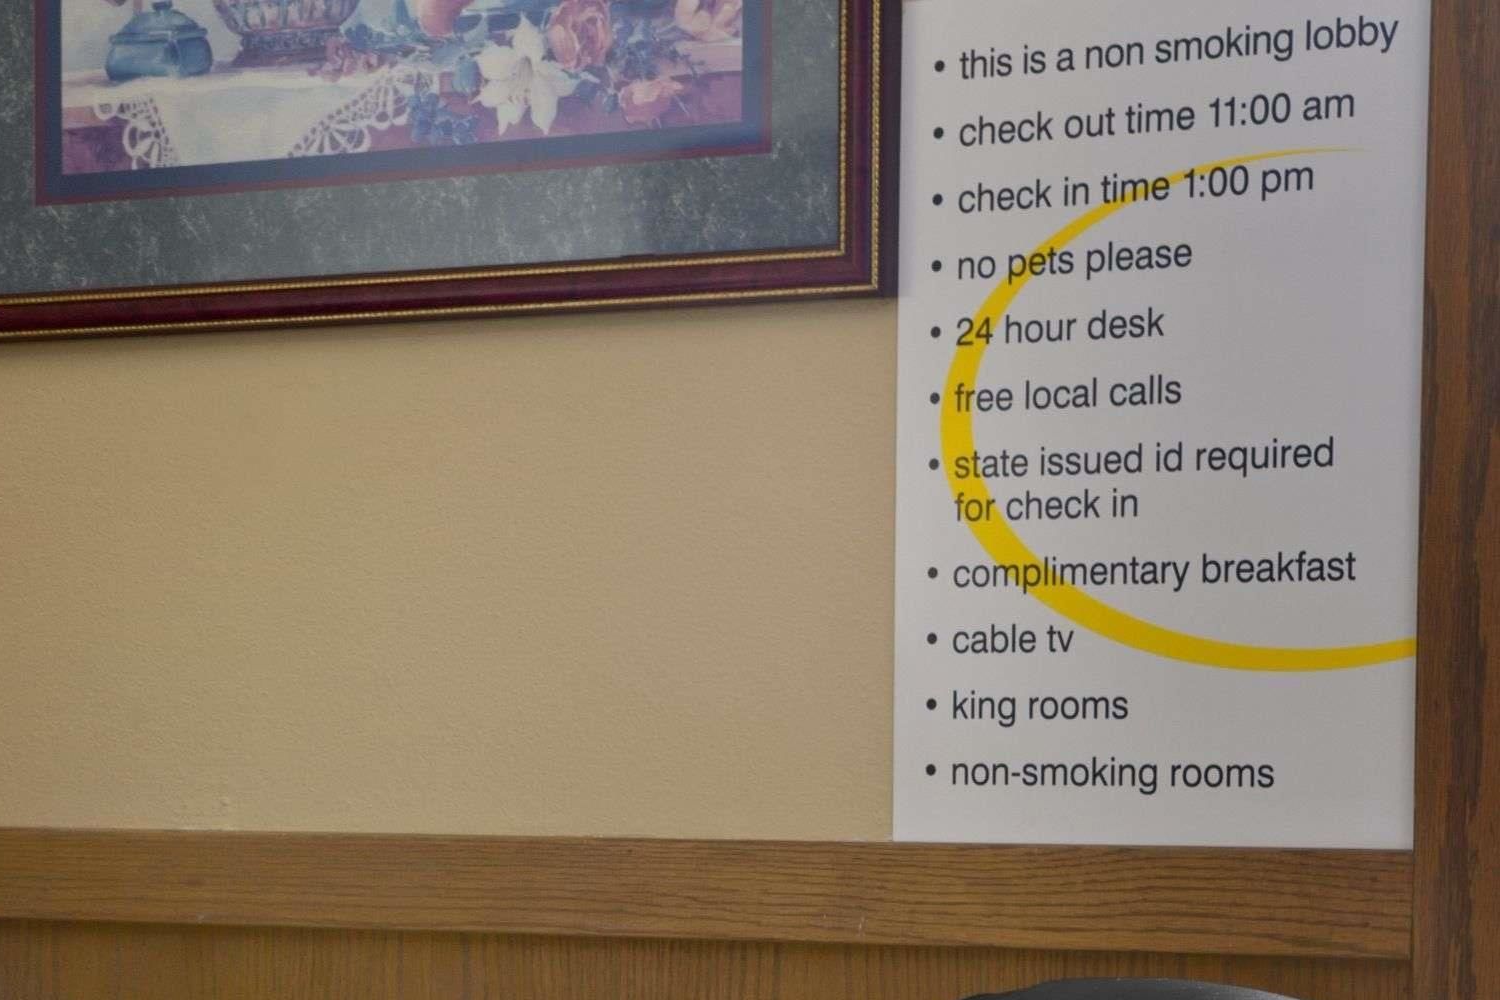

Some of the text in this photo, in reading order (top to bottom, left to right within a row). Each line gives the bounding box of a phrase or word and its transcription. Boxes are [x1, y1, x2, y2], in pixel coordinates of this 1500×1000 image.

[959, 15, 1399, 80] this is a non smoking lobby
[959, 93, 1354, 147] check out time 11:00 am
[958, 165, 1313, 214] check in time 1:00 pm
[958, 241, 1192, 285] no pets please
[956, 307, 1164, 346] 24 hour desk
[954, 374, 1181, 412] free local calls
[955, 436, 1333, 479] state issued id required
[954, 488, 1138, 522] for check in
[953, 550, 1356, 595] complimentary breakfast
[953, 624, 1074, 654] cable tv
[953, 690, 1128, 728] king rooms
[952, 756, 1274, 795] non-smoking rooms
